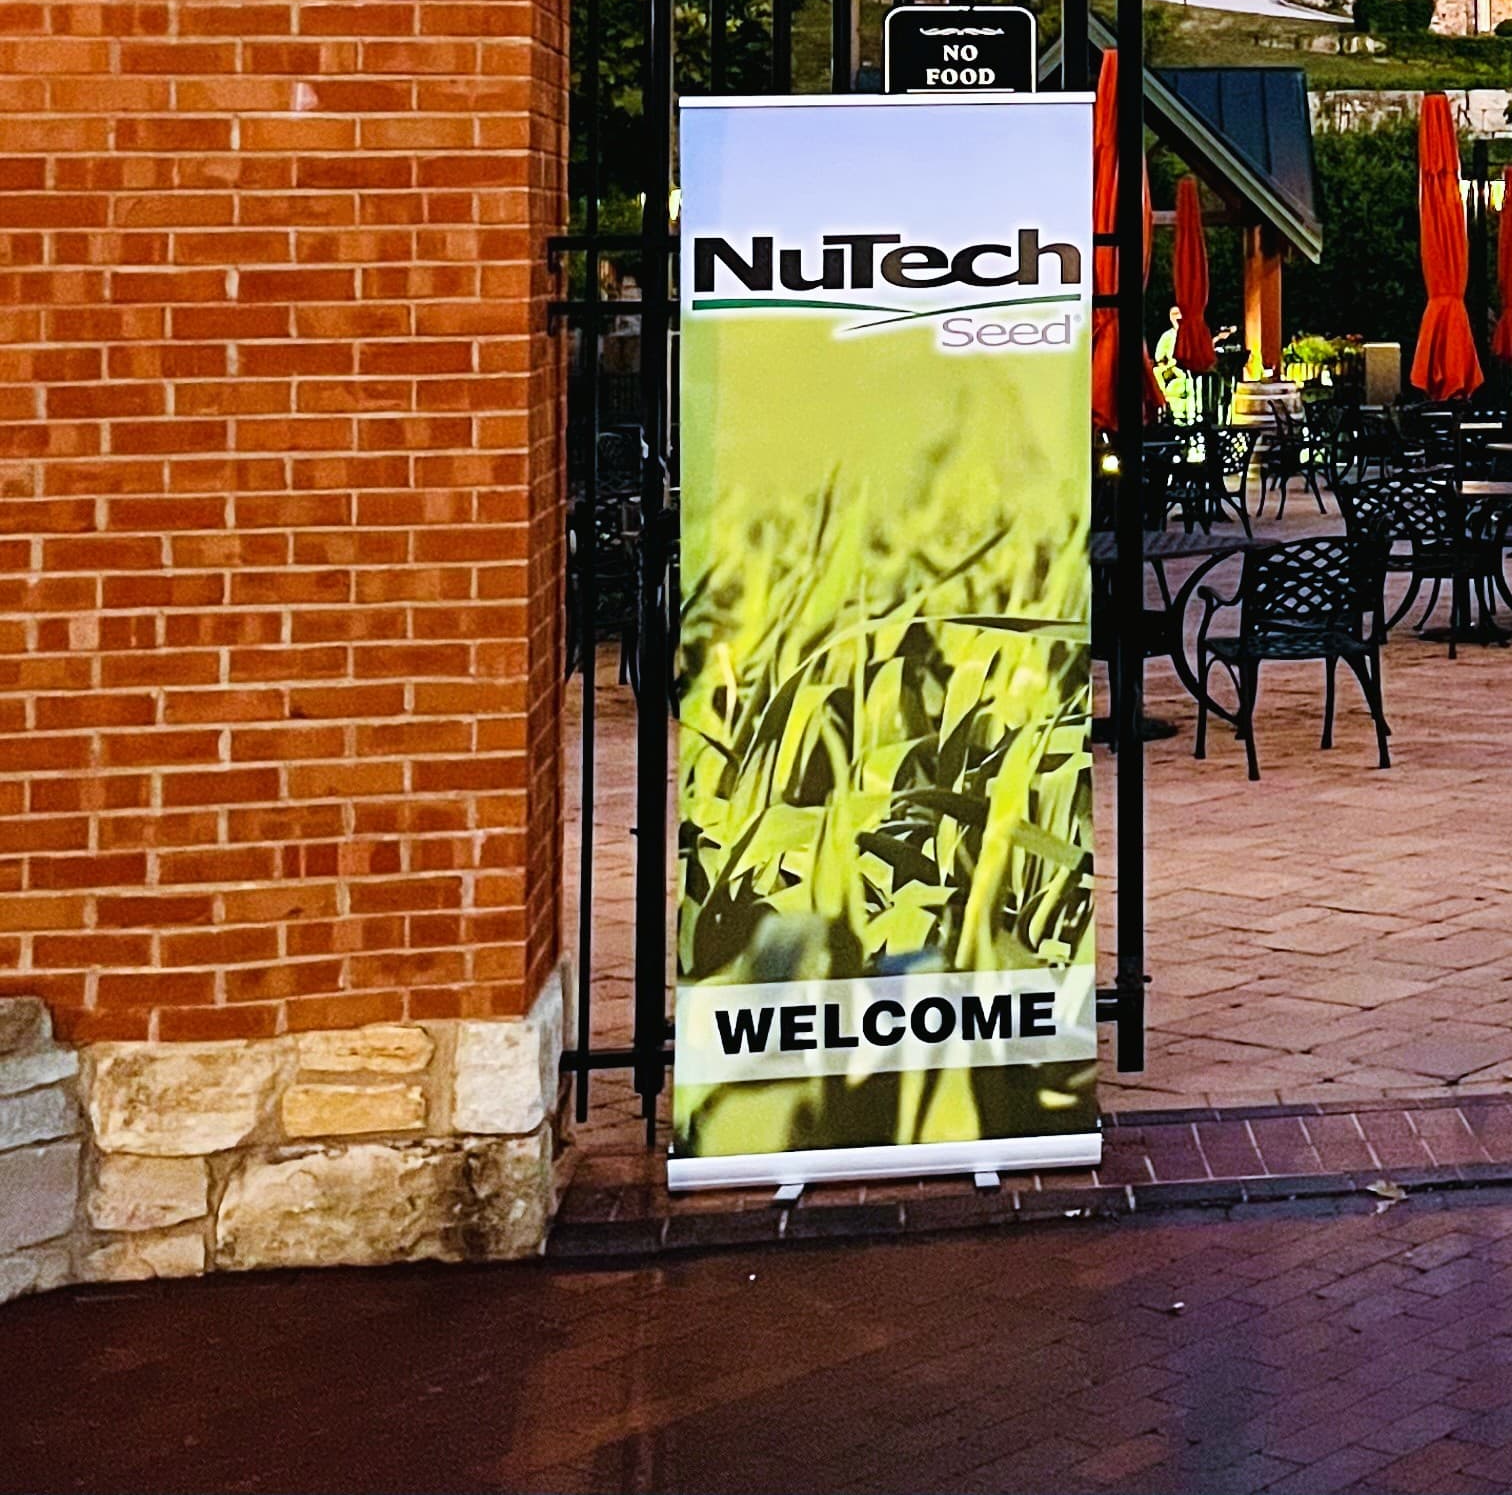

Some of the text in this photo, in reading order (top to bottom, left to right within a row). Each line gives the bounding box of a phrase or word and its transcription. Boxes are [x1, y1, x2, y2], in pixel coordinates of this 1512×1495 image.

[943, 44, 979, 62] NO
[925, 68, 996, 85] FOOD
[693, 229, 1082, 292] NuTech
[715, 992, 1057, 1055] WELCOME
